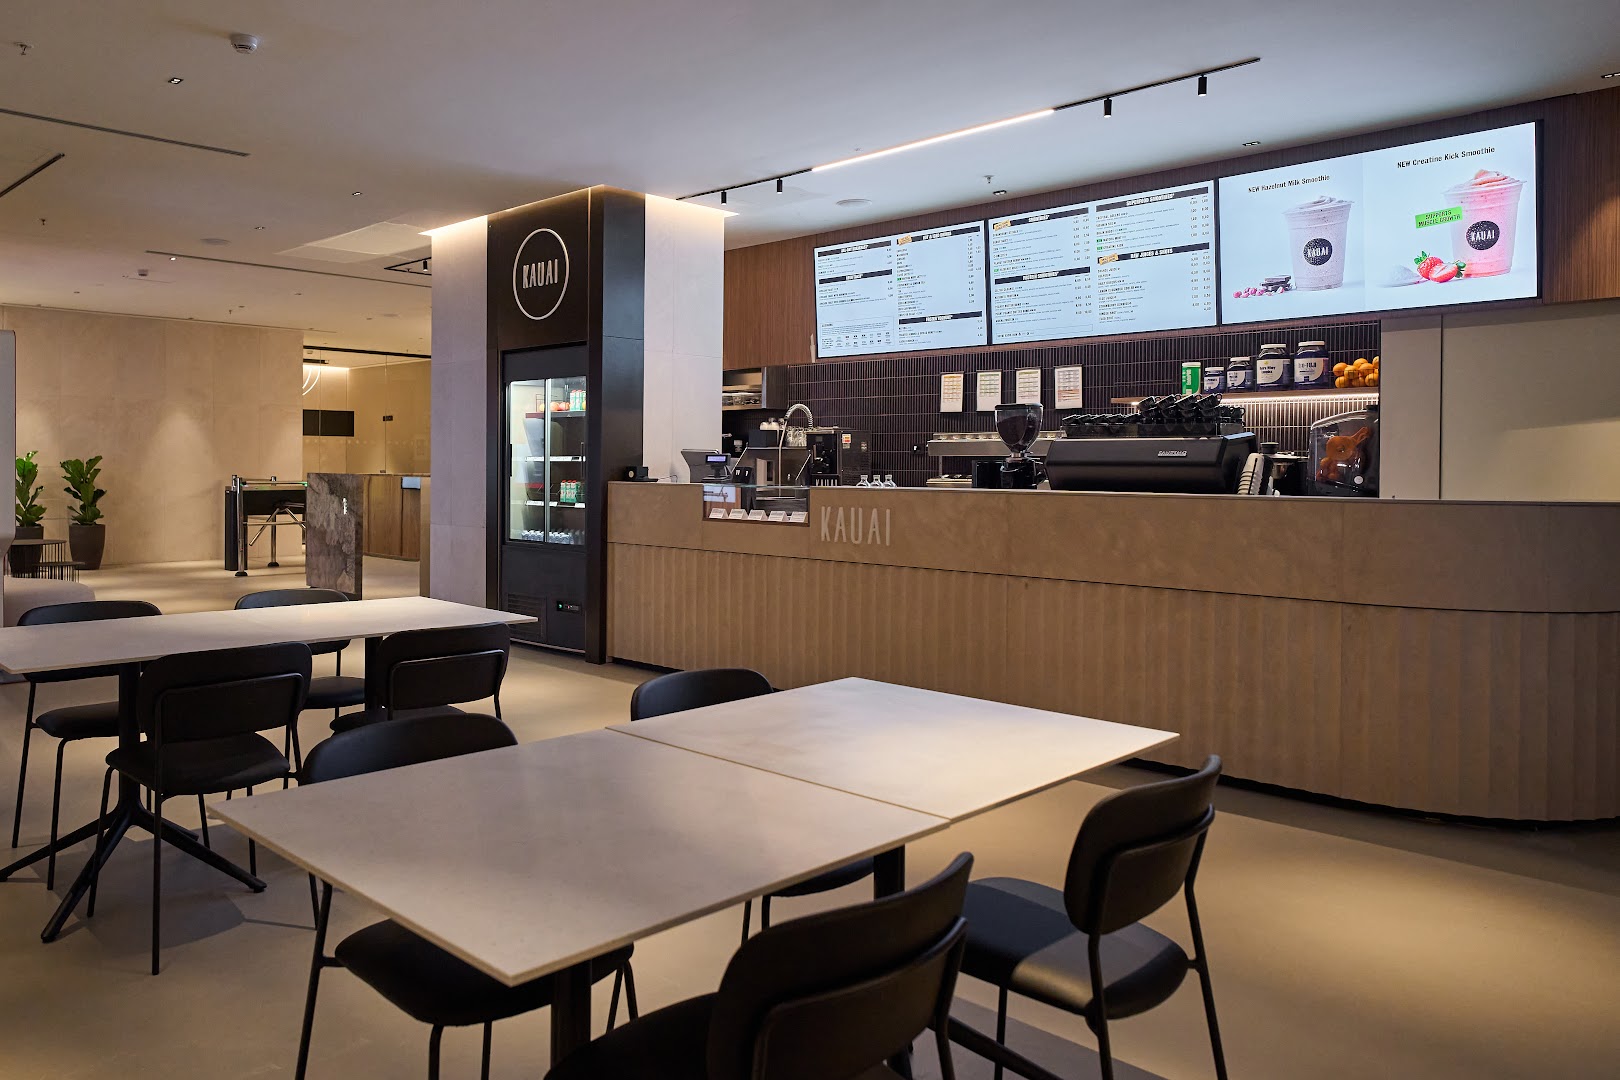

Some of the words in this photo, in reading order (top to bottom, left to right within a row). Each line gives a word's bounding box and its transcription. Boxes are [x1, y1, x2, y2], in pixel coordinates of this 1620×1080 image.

[1397, 161, 1411, 169] NEW
[1412, 156, 1443, 166] Creatine
[1444, 151, 1460, 161] Kick
[1461, 146, 1495, 158] Smoothie
[1261, 182, 1286, 191] Hazelnut
[1287, 178, 1300, 187] Milk
[1301, 174, 1330, 185] Smoothie
[1418, 218, 1439, 227] MUSCLE
[1439, 213, 1461, 223] GROWTH
[1425, 209, 1452, 219] SUPPORTS
[1470, 229, 1495, 241] KAUAI
[1307, 246, 1329, 258] KAUAI
[522, 258, 558, 289] KAUAI
[821, 505, 891, 547] KAUAI
